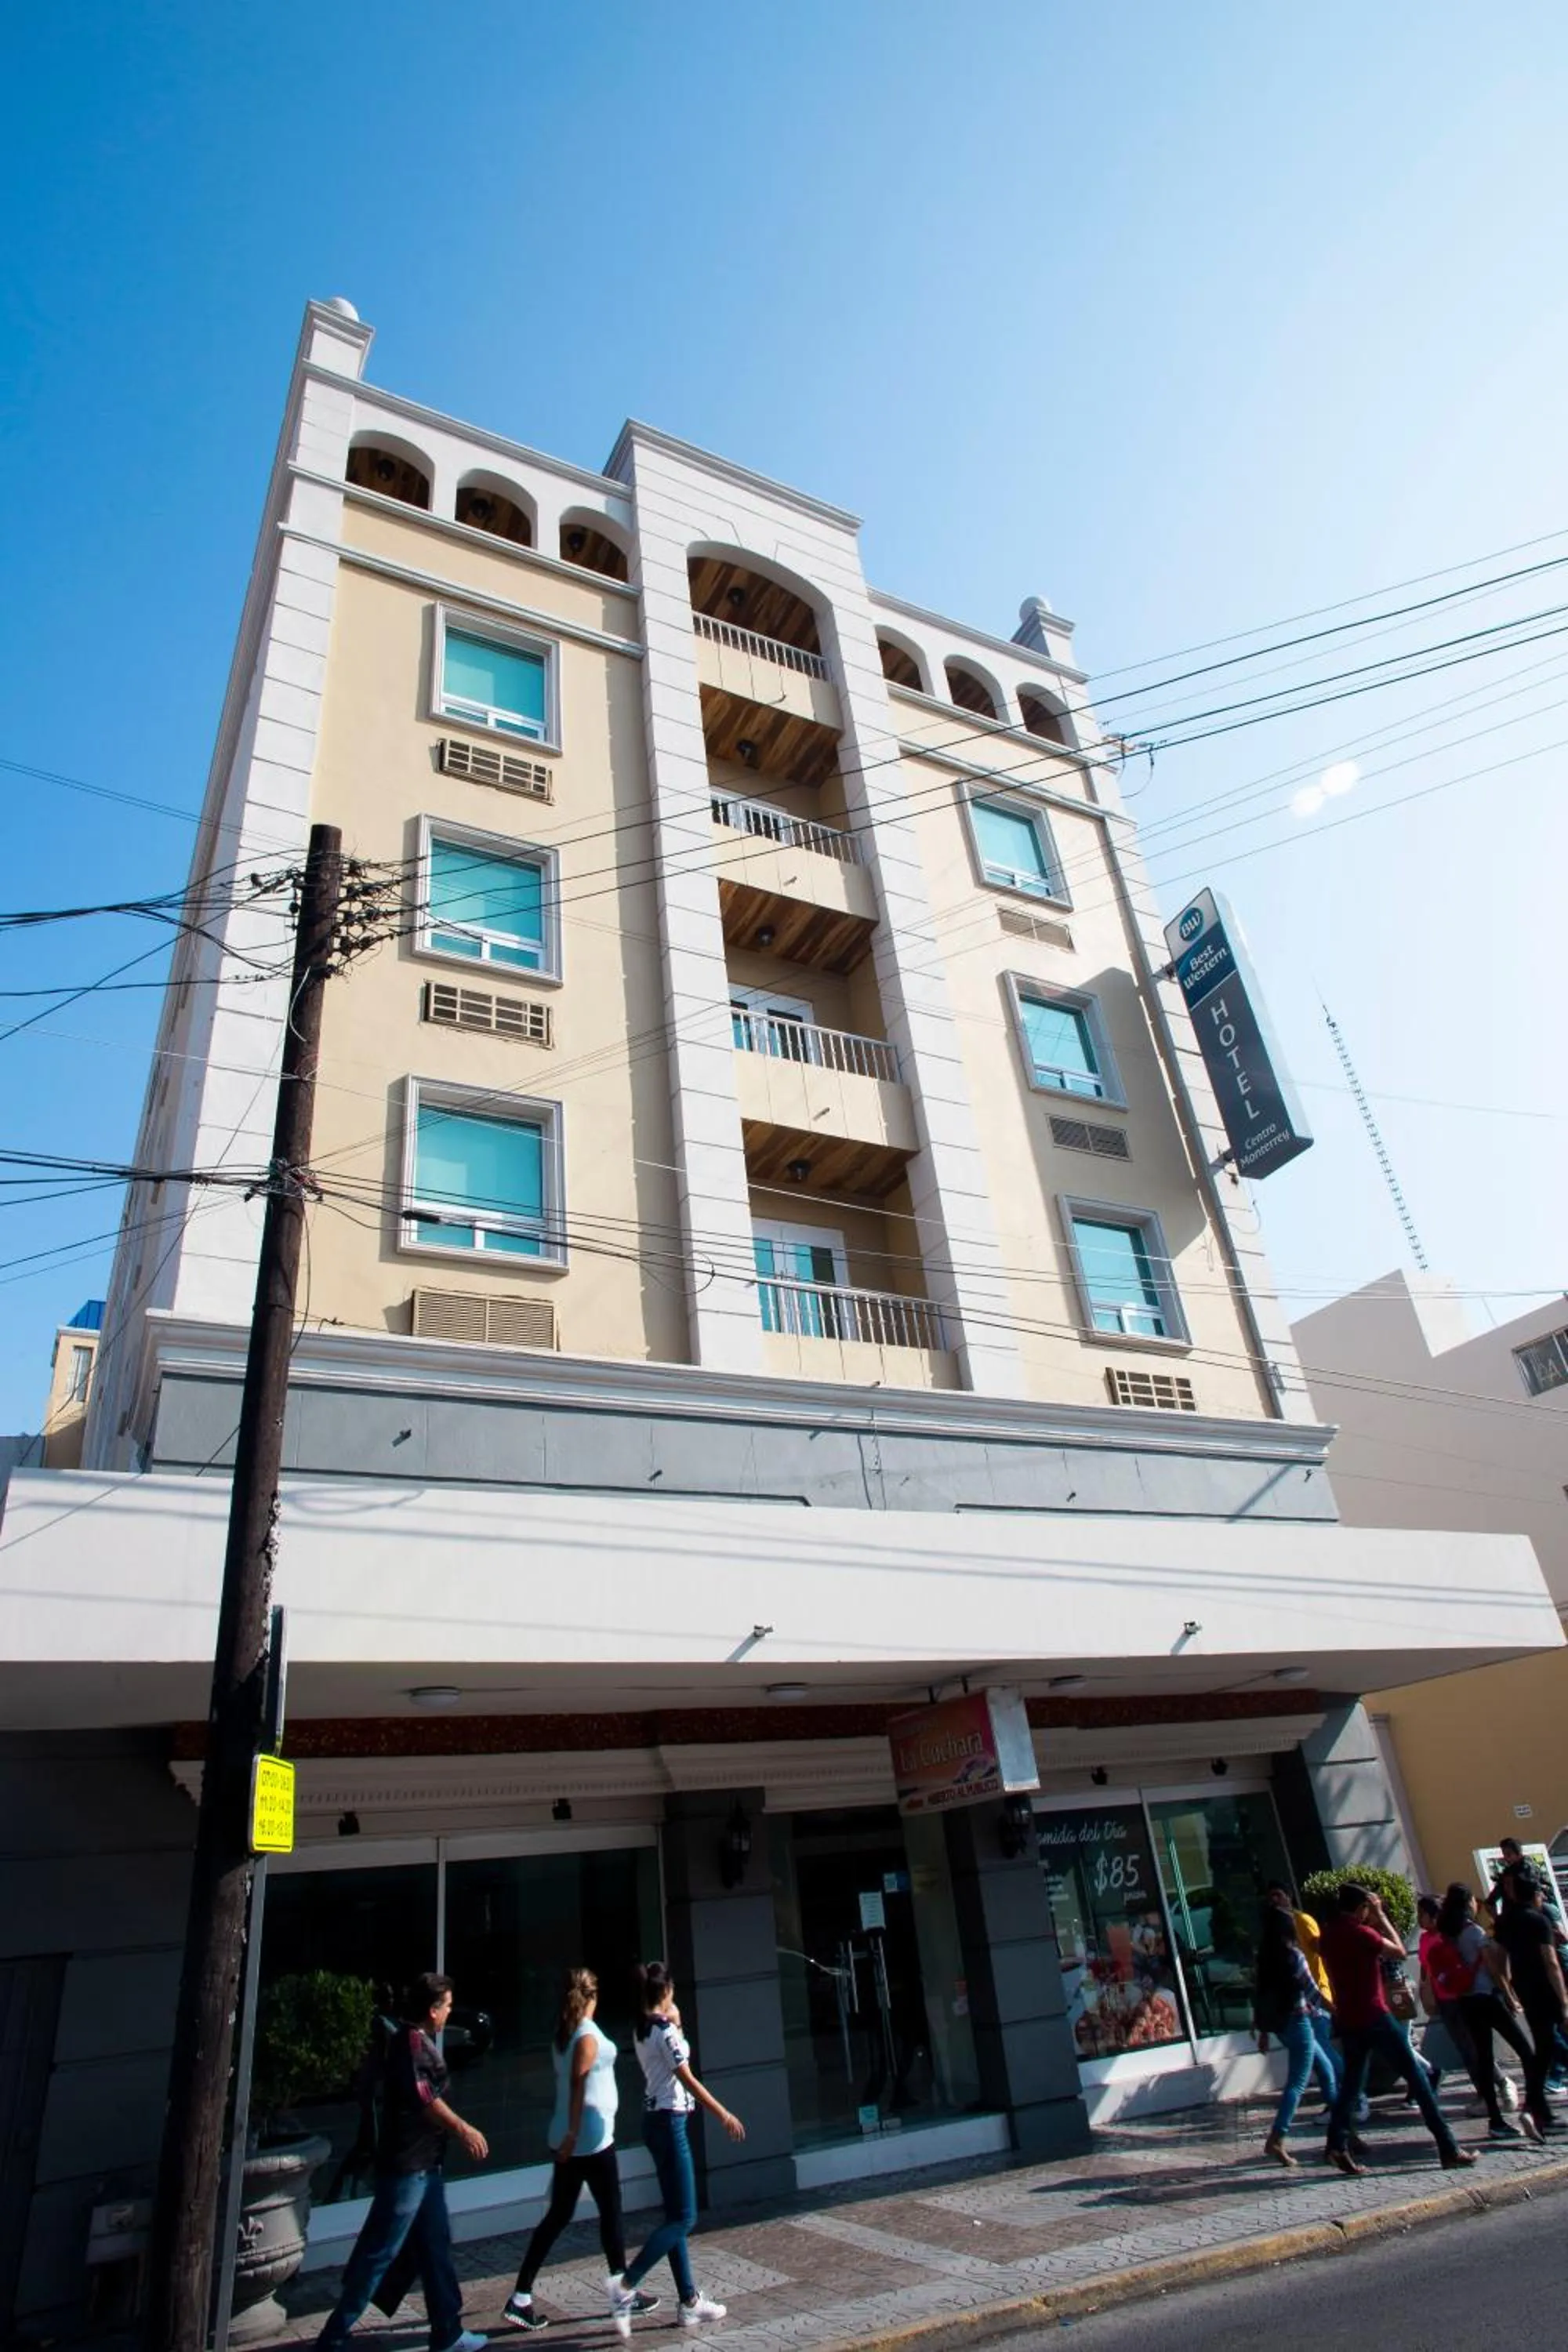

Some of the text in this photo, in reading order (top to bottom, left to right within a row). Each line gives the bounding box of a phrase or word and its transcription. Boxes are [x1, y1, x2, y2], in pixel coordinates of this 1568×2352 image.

[1181, 912, 1201, 938] BW
[1183, 947, 1228, 989] Western
[1189, 945, 1214, 971] Best
[1210, 999, 1261, 1120] HOTEL
[1240, 1129, 1290, 1169] Monterrey
[1244, 1123, 1277, 1150] Centro
[1094, 1850, 1141, 1896] $85
